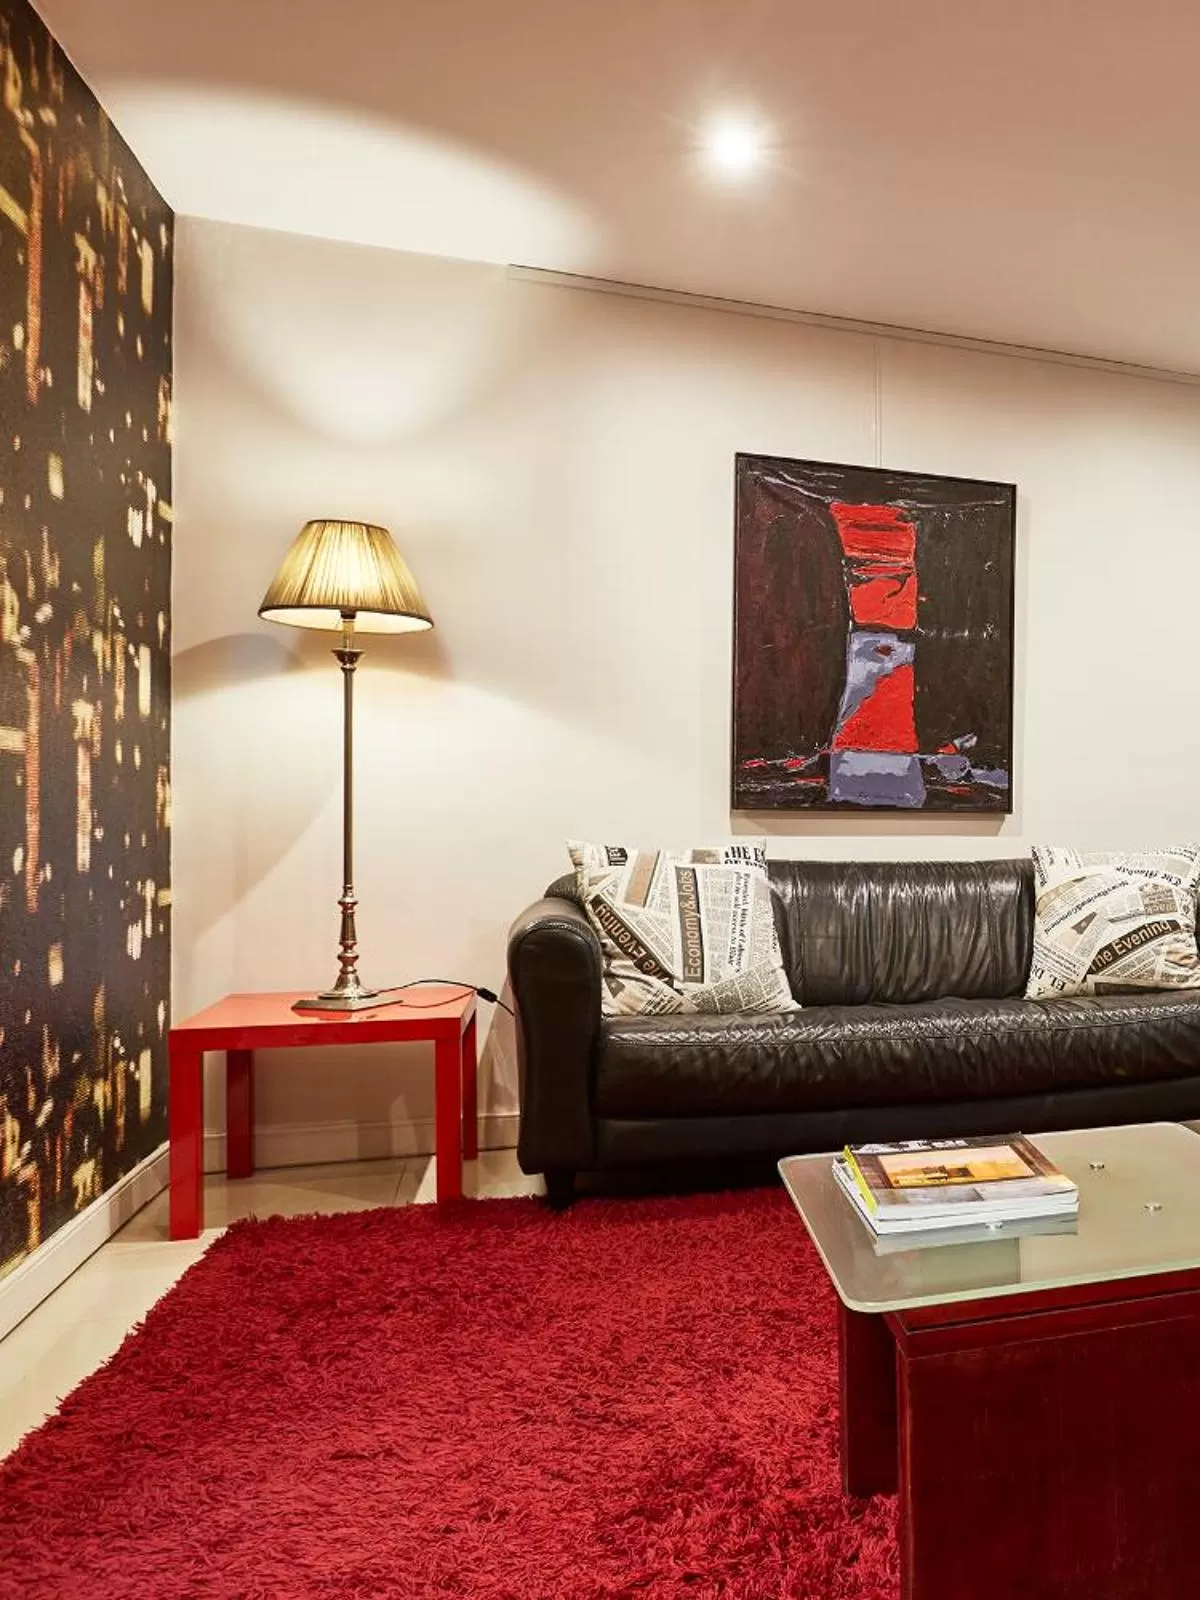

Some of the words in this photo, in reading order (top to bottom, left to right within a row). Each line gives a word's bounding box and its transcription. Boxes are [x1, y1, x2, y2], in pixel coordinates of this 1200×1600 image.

[594, 903, 646, 958] Evening
[680, 870, 703, 978] Economy&Jobs
[1114, 920, 1171, 956] Evening
